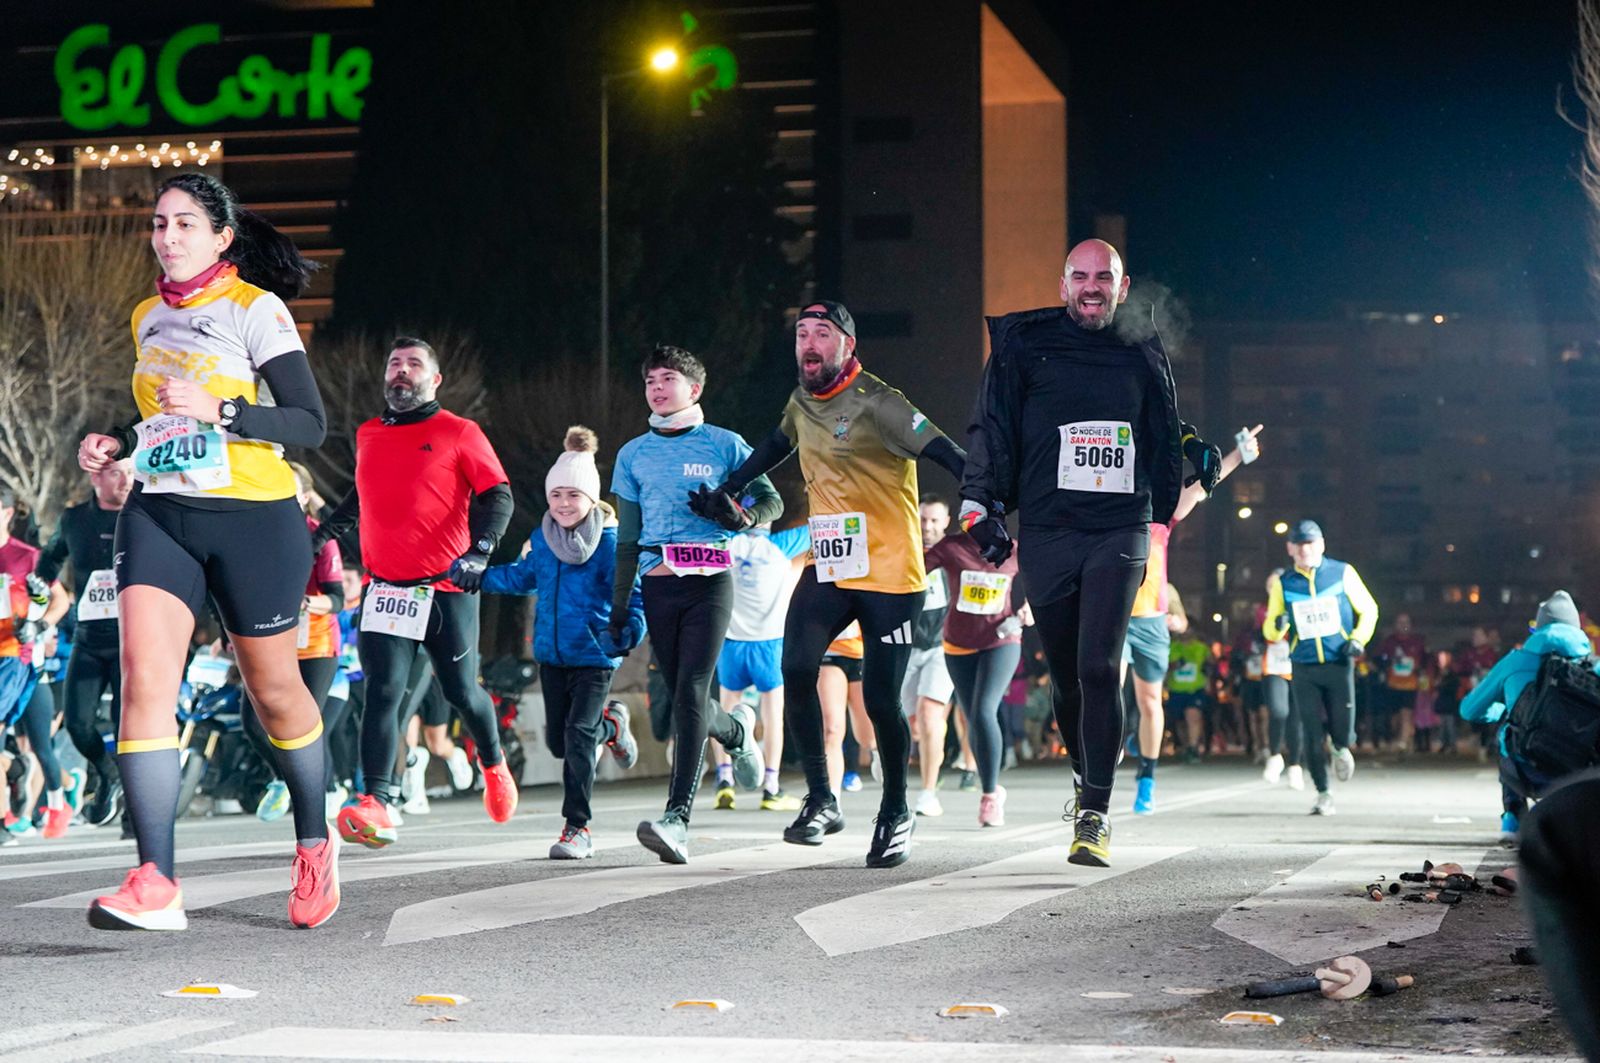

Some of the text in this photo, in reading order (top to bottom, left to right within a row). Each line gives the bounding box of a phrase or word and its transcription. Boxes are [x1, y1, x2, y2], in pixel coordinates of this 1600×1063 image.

[54, 23, 373, 130] El Corte
[148, 434, 207, 468] 8240
[1071, 436, 1086, 444] SAN
[1074, 446, 1124, 469] 5068
[672, 547, 726, 564] 15025
[814, 537, 853, 559] 5067
[375, 596, 419, 618] 5066
